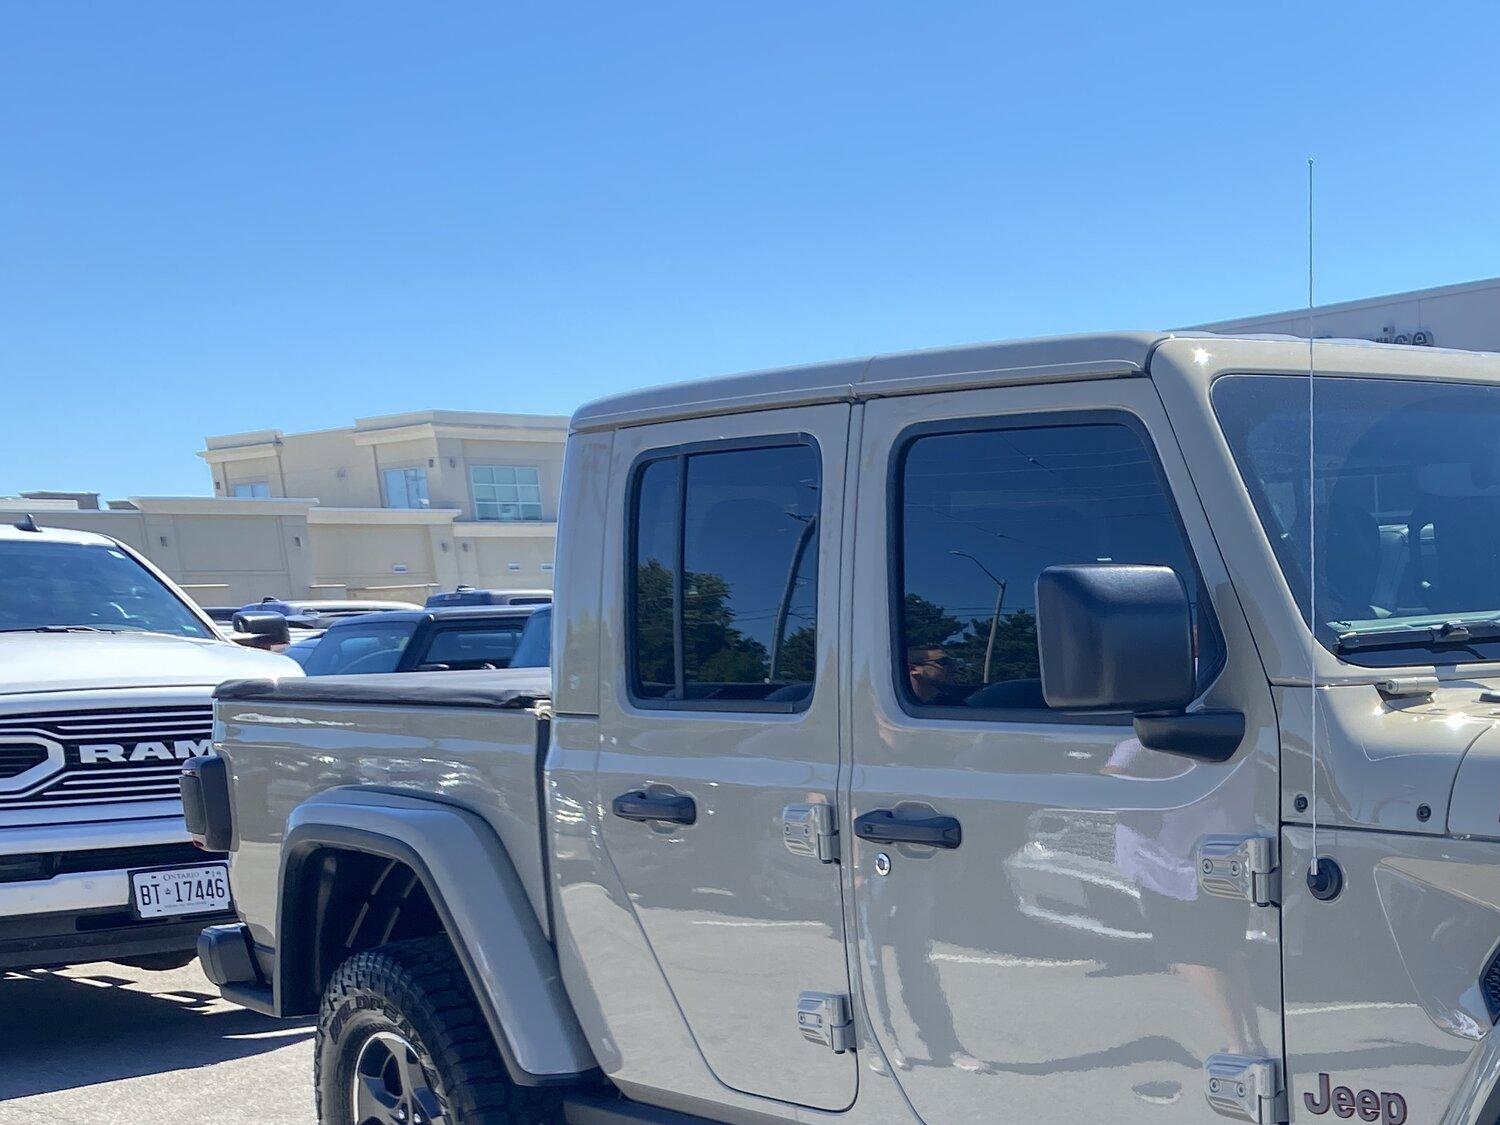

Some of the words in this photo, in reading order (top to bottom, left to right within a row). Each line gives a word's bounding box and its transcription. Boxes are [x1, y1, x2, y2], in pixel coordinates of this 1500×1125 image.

[79, 739, 214, 763] RAM
[163, 871, 200, 881] ONTARIO
[140, 884, 160, 906] BT
[175, 879, 225, 902] 17446
